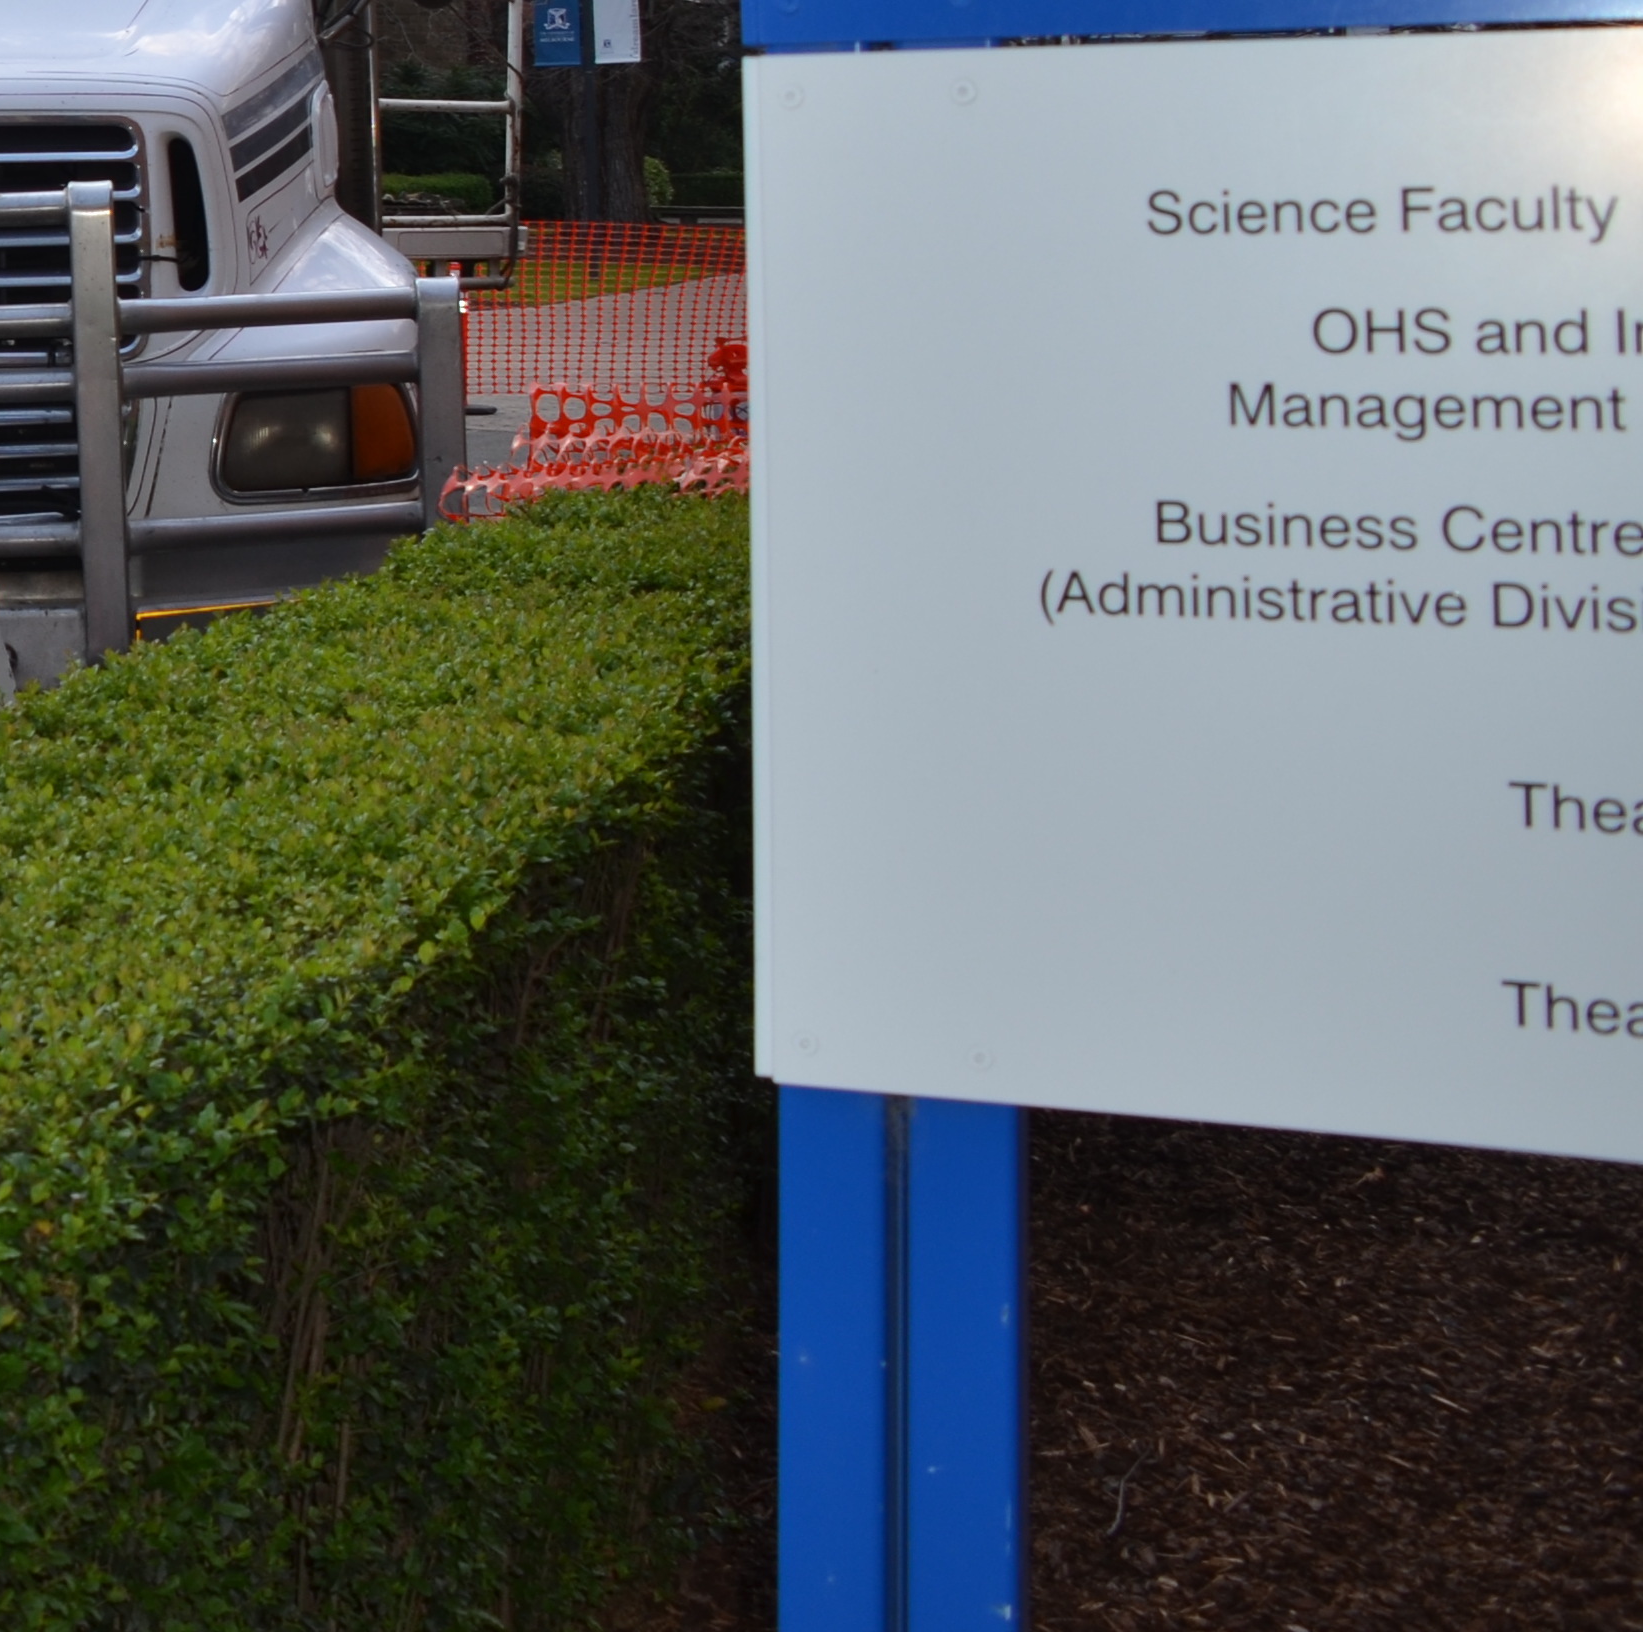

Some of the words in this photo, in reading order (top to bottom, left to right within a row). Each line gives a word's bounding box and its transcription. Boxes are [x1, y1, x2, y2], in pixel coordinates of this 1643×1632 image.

[1148, 190, 1376, 235] Science
[1401, 186, 1614, 243] Faculty
[1313, 308, 1451, 354] OHS
[1476, 310, 1588, 355] and
[1230, 382, 1626, 442] Management
[1156, 500, 1417, 551] Business
[1442, 505, 1643, 557] Centre
[1041, 571, 1466, 627] (Administrative
